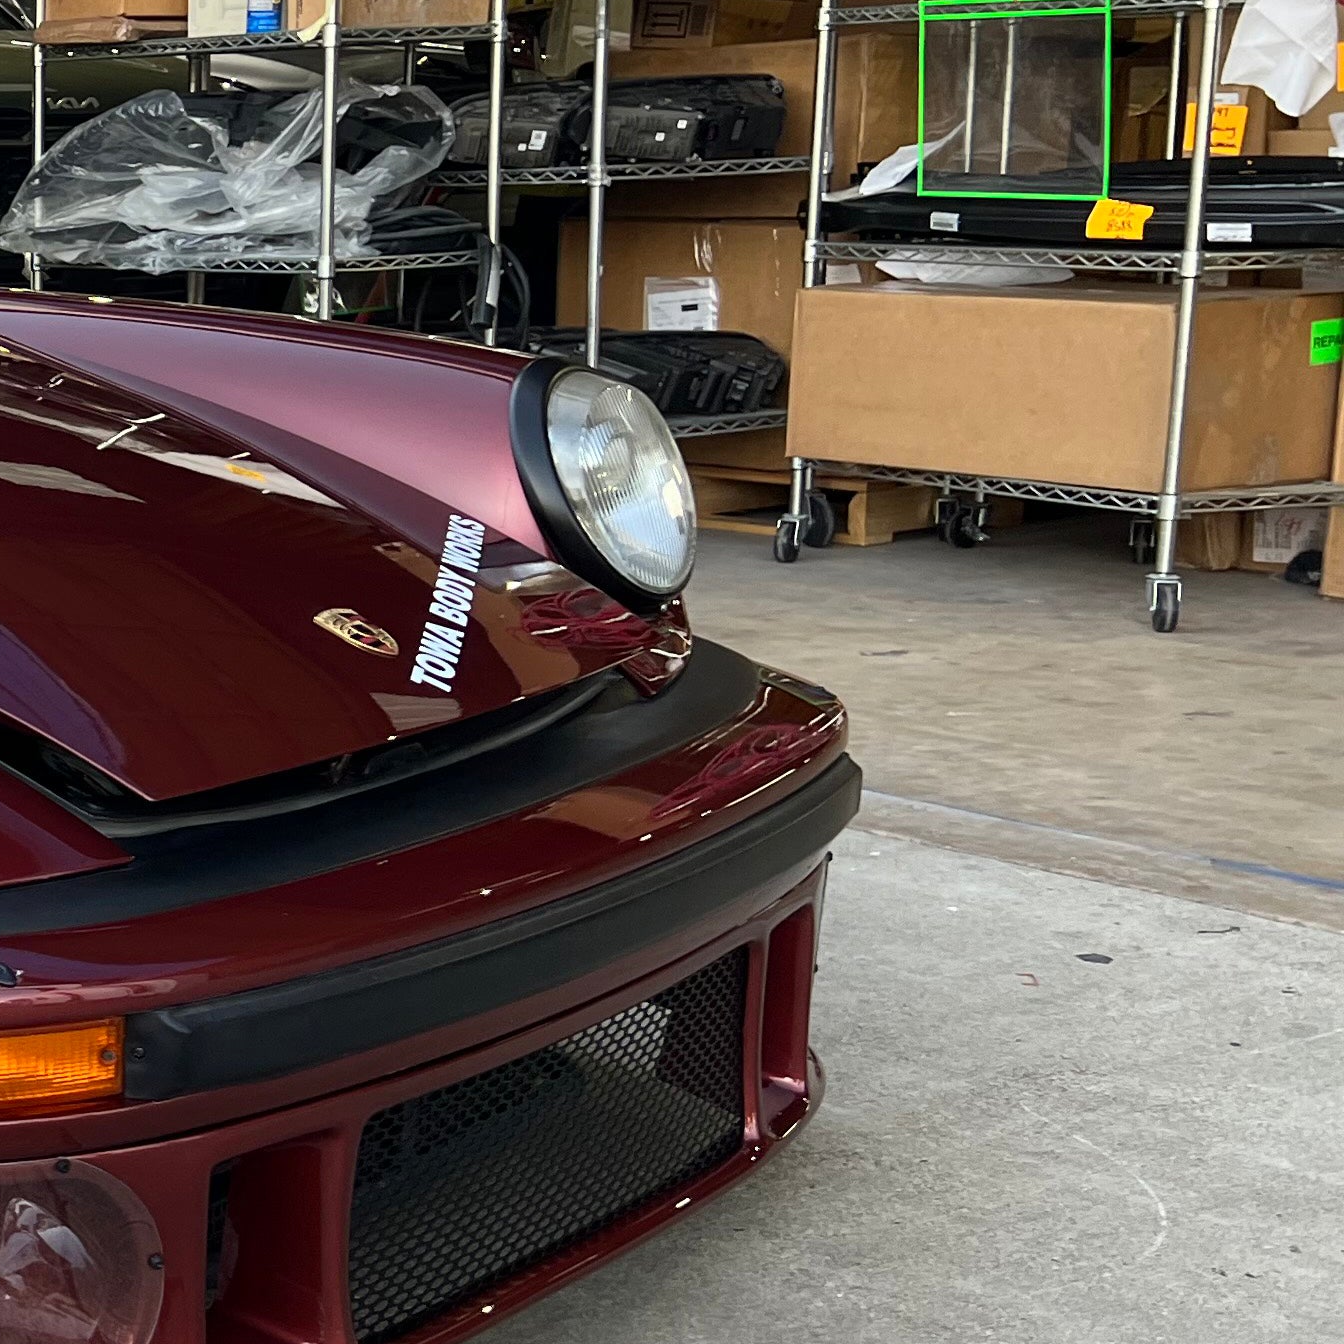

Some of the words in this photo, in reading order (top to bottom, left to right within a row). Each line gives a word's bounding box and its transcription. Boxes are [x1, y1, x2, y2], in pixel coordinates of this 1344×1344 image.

[440, 514, 485, 573] WORKS
[429, 565, 476, 627] BODY
[410, 622, 464, 693] TOWA
